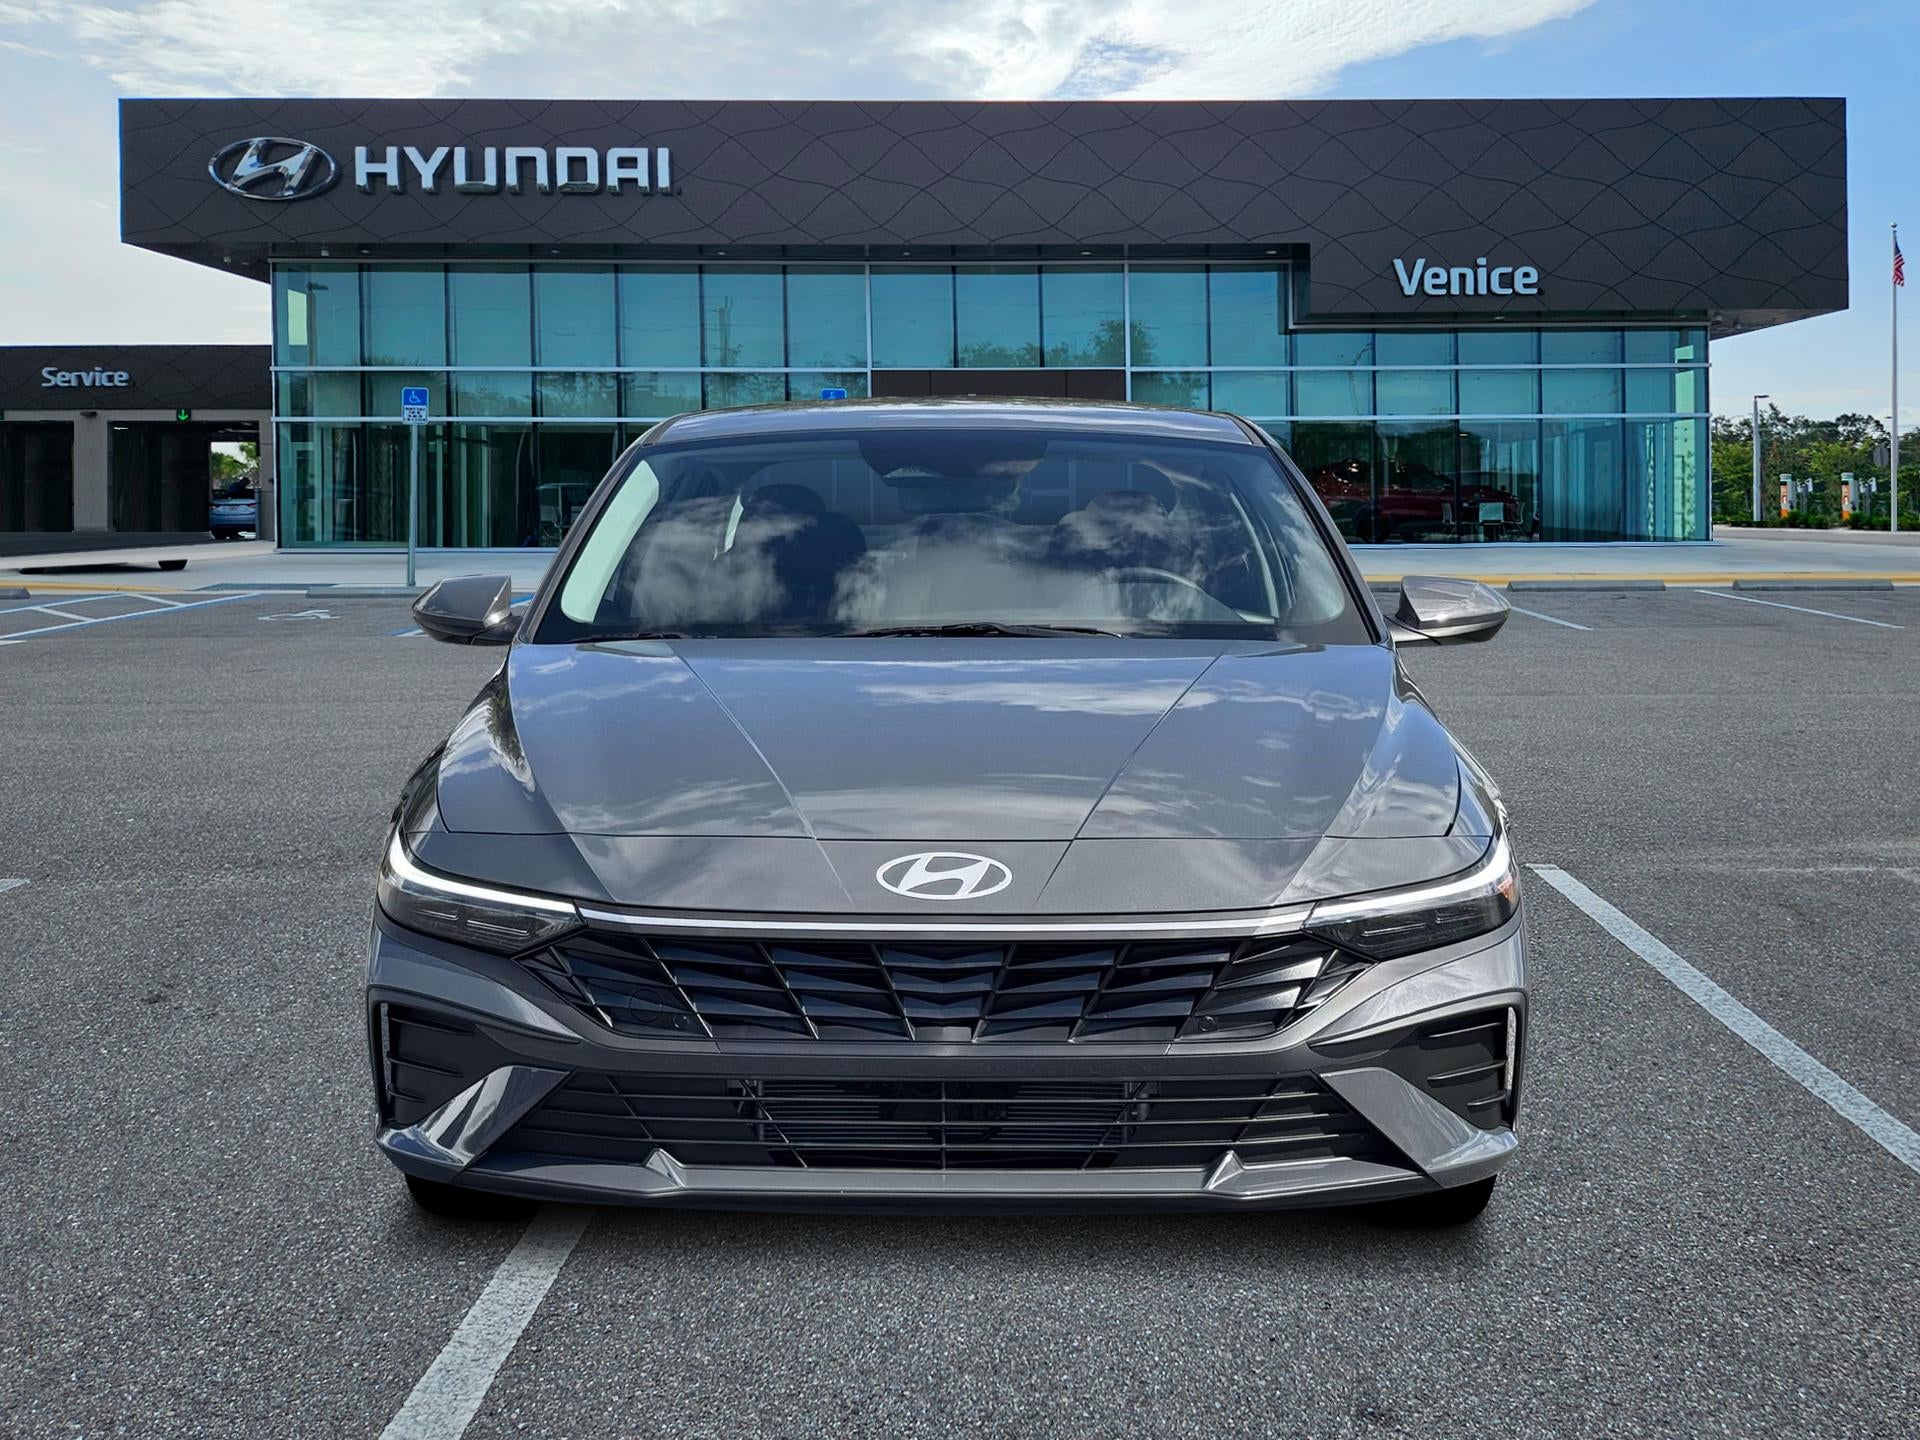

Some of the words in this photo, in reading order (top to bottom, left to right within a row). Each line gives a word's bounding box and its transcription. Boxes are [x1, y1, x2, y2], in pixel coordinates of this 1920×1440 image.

[353, 146, 672, 194] HYUNDAI
[1392, 256, 1539, 296] Venice
[41, 366, 130, 388] Service
